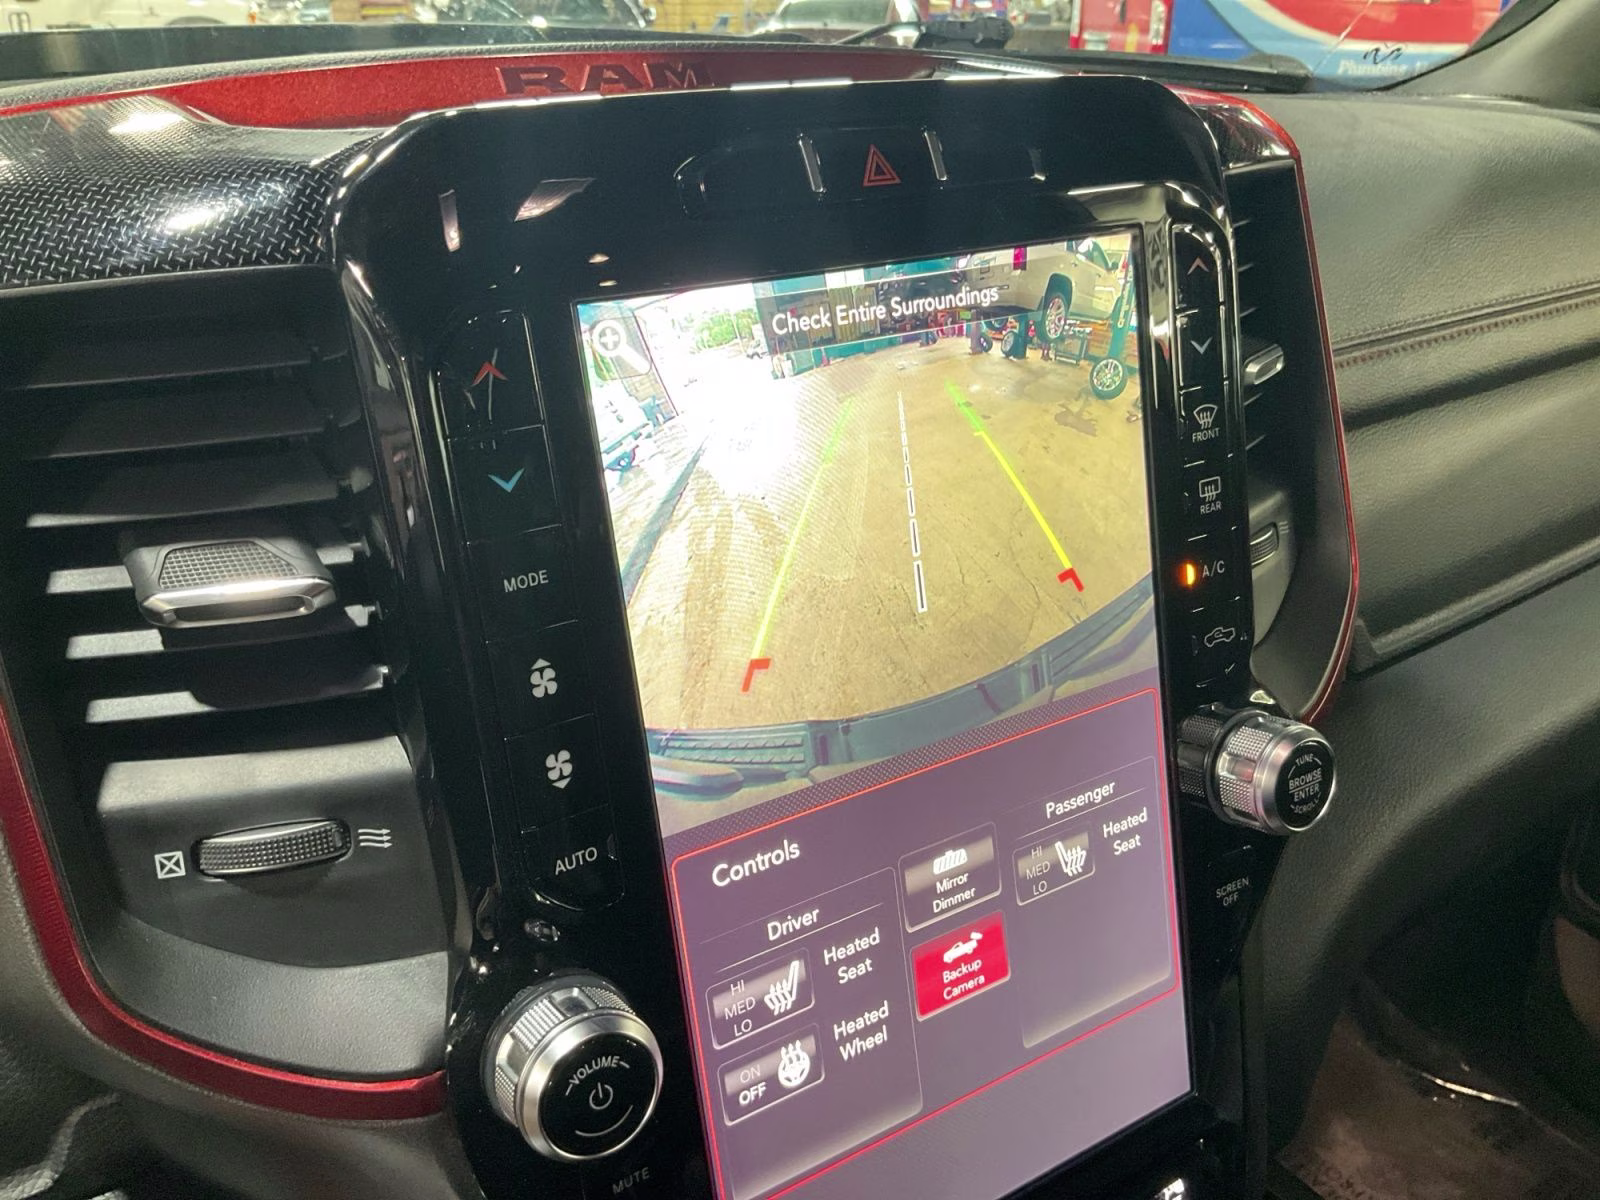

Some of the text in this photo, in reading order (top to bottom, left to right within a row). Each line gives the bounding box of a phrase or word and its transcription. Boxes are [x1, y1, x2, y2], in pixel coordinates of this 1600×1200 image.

[496, 62, 715, 95] RAM
[772, 285, 999, 335] Check Entire Surroundings
[1192, 428, 1220, 442] FRONT
[1200, 501, 1222, 515] REAR
[503, 569, 549, 593] MODE
[1202, 560, 1226, 578] A/C
[1295, 752, 1314, 767] TUNE
[1289, 767, 1322, 789] BROWSE
[1045, 781, 1116, 819] Passenger
[1294, 783, 1320, 801] ENTER
[1102, 806, 1149, 838] Heated
[1030, 845, 1043, 860] HI
[1112, 833, 1142, 856] Seat
[554, 846, 598, 876] AUTO
[712, 839, 800, 887] Controls
[1025, 860, 1051, 880] MED
[935, 871, 969, 894] Mirror
[1032, 880, 1048, 896] LO
[1216, 877, 1249, 898] SCREEN
[932, 886, 976, 914] Dimmer
[1222, 891, 1239, 907] OFF
[767, 908, 820, 942] Driver
[823, 927, 880, 965] Heated
[836, 957, 873, 985] Seat
[943, 959, 982, 983] Backup
[729, 979, 746, 997] HI
[943, 975, 985, 1000] Camera
[723, 996, 757, 1021] MED
[833, 1000, 889, 1040] Heated
[733, 1018, 754, 1038] LO
[839, 1025, 888, 1061] Wheel
[568, 1055, 620, 1085] VOLUME
[739, 1064, 762, 1085] ON
[738, 1081, 768, 1107] OFF
[611, 1166, 651, 1195] MUTE
